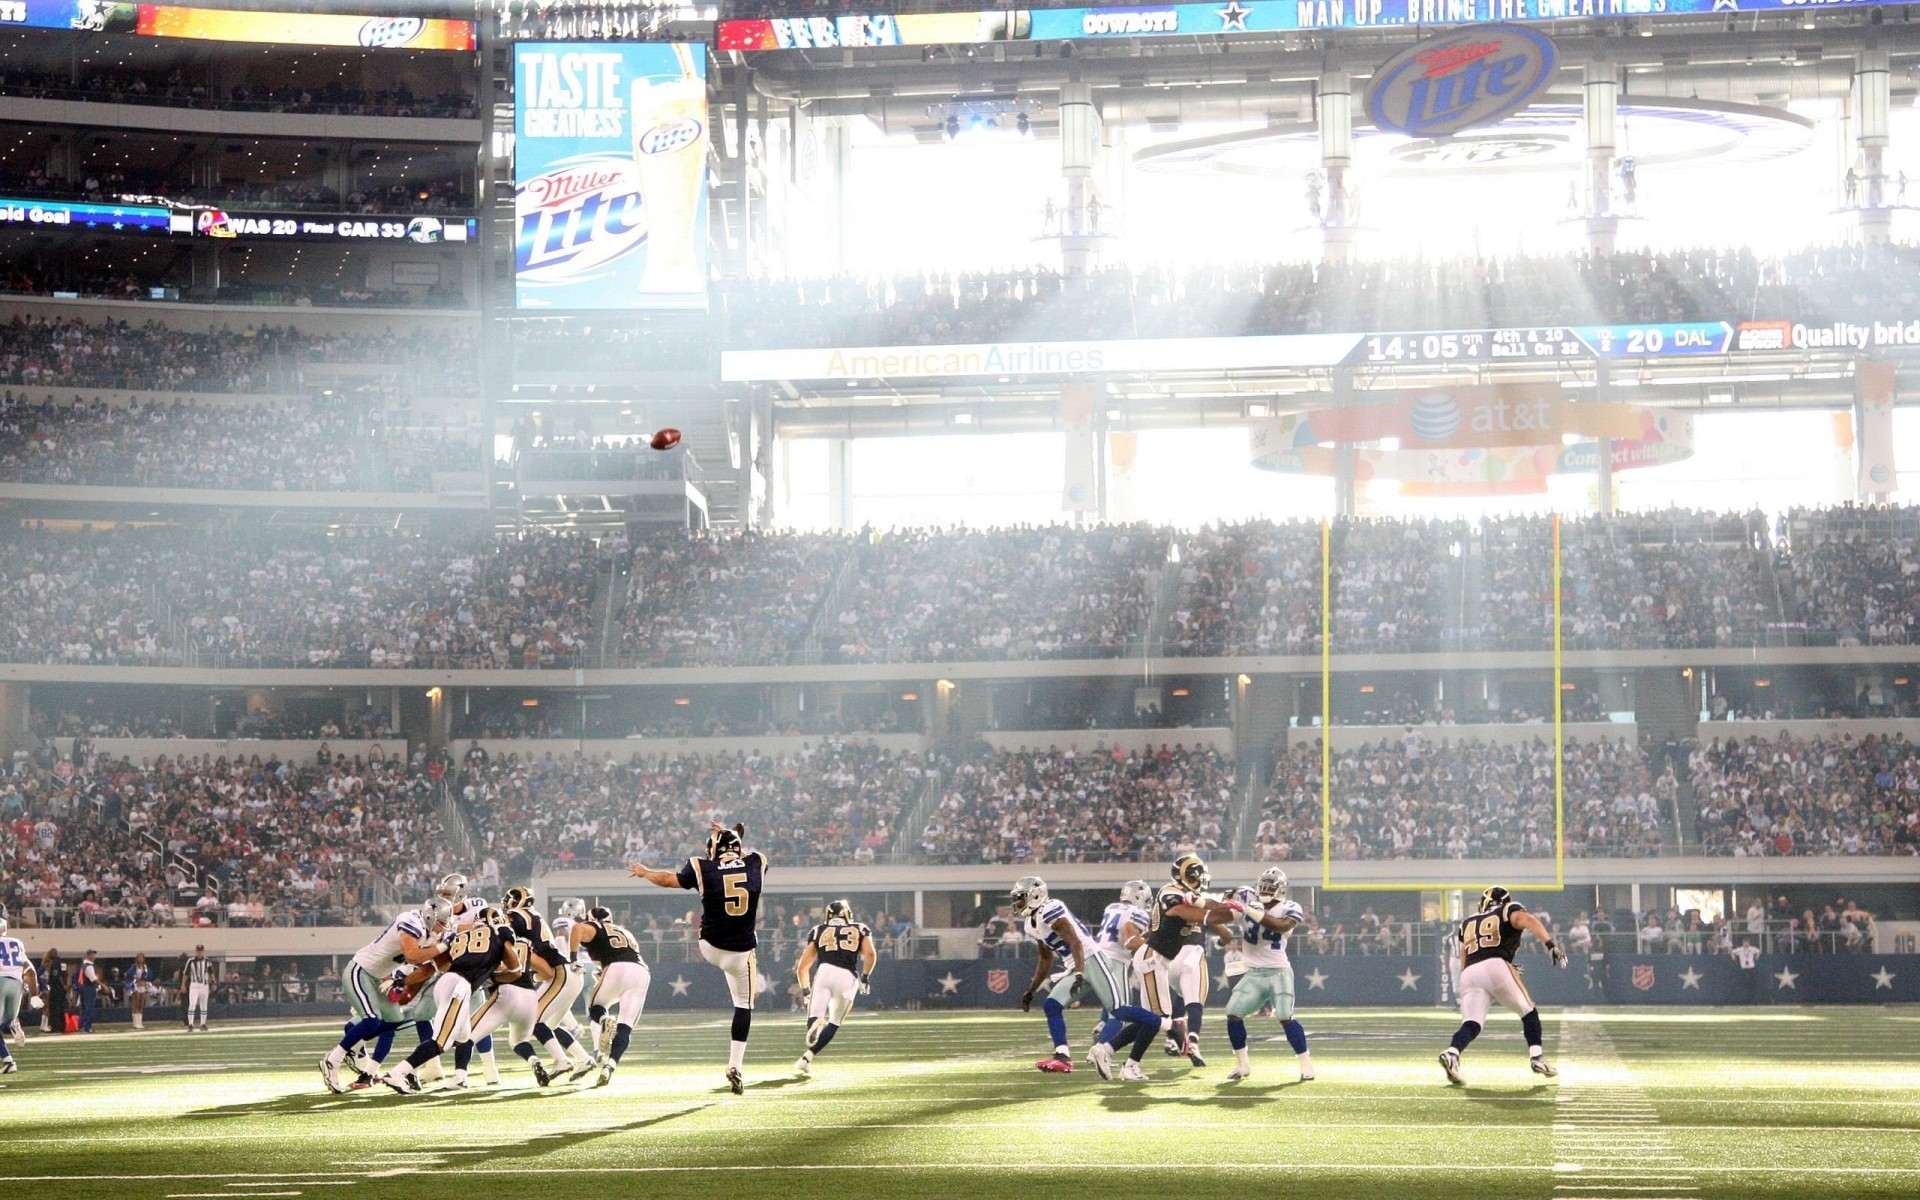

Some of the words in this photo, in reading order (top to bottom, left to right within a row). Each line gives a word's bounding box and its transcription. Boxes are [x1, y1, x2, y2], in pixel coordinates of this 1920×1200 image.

[1083, 10, 1178, 34] COWBOYS
[1298, 0, 1344, 28] MAN
[1487, 0, 1527, 19] THE
[1415, 41, 1503, 74] Miller
[519, 53, 623, 108] TASTE
[1406, 53, 1528, 132] Lite
[524, 108, 624, 137] GREATNESS
[528, 170, 624, 205] Miller
[29, 208, 71, 224] Goal
[228, 218, 271, 235] WAS
[272, 219, 298, 235] 20
[303, 222, 334, 235] Final
[337, 221, 379, 237] CAR
[381, 222, 405, 238] 33
[516, 191, 643, 273] Lite
[1367, 334, 1459, 361] 14:05
[1461, 334, 1484, 345] QTR
[1491, 342, 1528, 357] Ball
[1534, 343, 1553, 356] On
[1561, 341, 1580, 355] 32
[1492, 330, 1521, 343] 4th
[1545, 329, 1564, 342] 10
[1626, 329, 1664, 353] 20
[1674, 329, 1712, 347] DAL
[1791, 322, 1870, 350] Quality
[1467, 344, 1478, 357] 4
[1471, 398, 1552, 433] at&t
[1564, 447, 1630, 467] Conct
[722, 872, 749, 917] 5
[818, 926, 860, 953] 43
[1463, 914, 1502, 955] 49
[0, 941, 23, 967] 42
